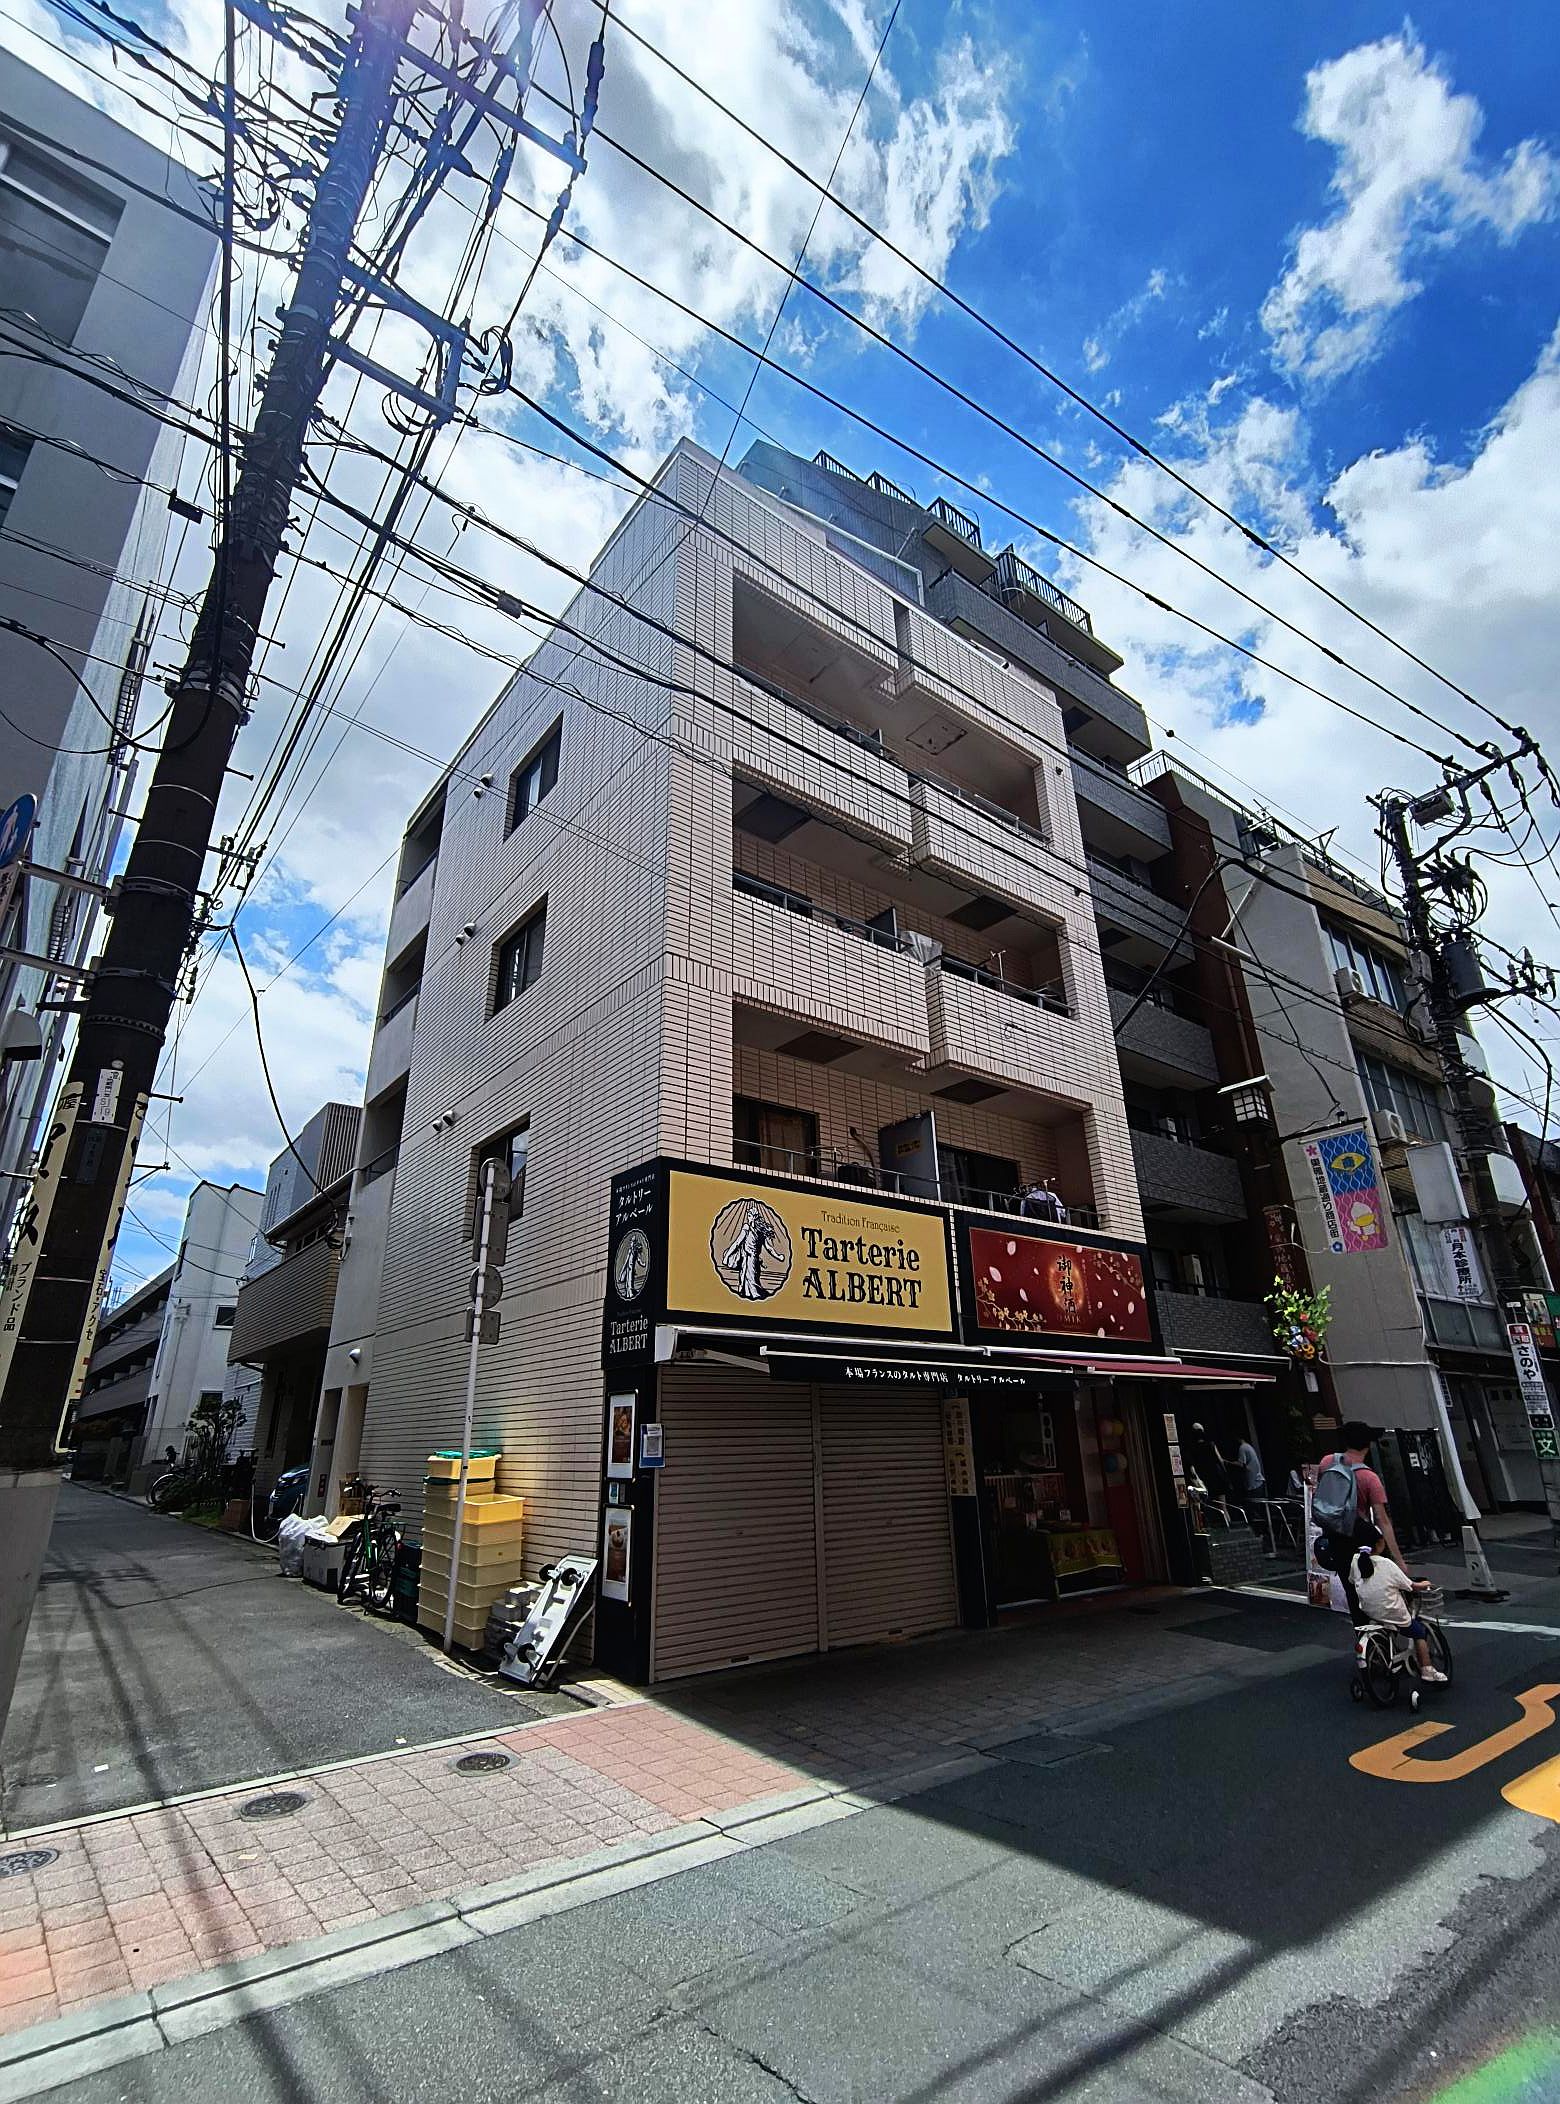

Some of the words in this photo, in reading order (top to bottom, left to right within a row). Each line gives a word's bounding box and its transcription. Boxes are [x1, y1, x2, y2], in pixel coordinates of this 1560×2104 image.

[618, 1188, 651, 1210] タルトリー
[615, 1203, 654, 1226] アルベール
[821, 1210, 860, 1227] Tradition
[861, 1217, 901, 1233] Française
[801, 1226, 920, 1271] Tarterie
[803, 1267, 921, 1308] ALBERT
[1056, 1254, 1076, 1314] 御神酒
[3, 1262, 32, 1331] ブランド品
[610, 1314, 648, 1335] Tarterie
[610, 1333, 648, 1354] ALBERT
[1517, 1345, 1536, 1380] さのや
[845, 1366, 949, 1383] 本場フランスのタルト専門店
